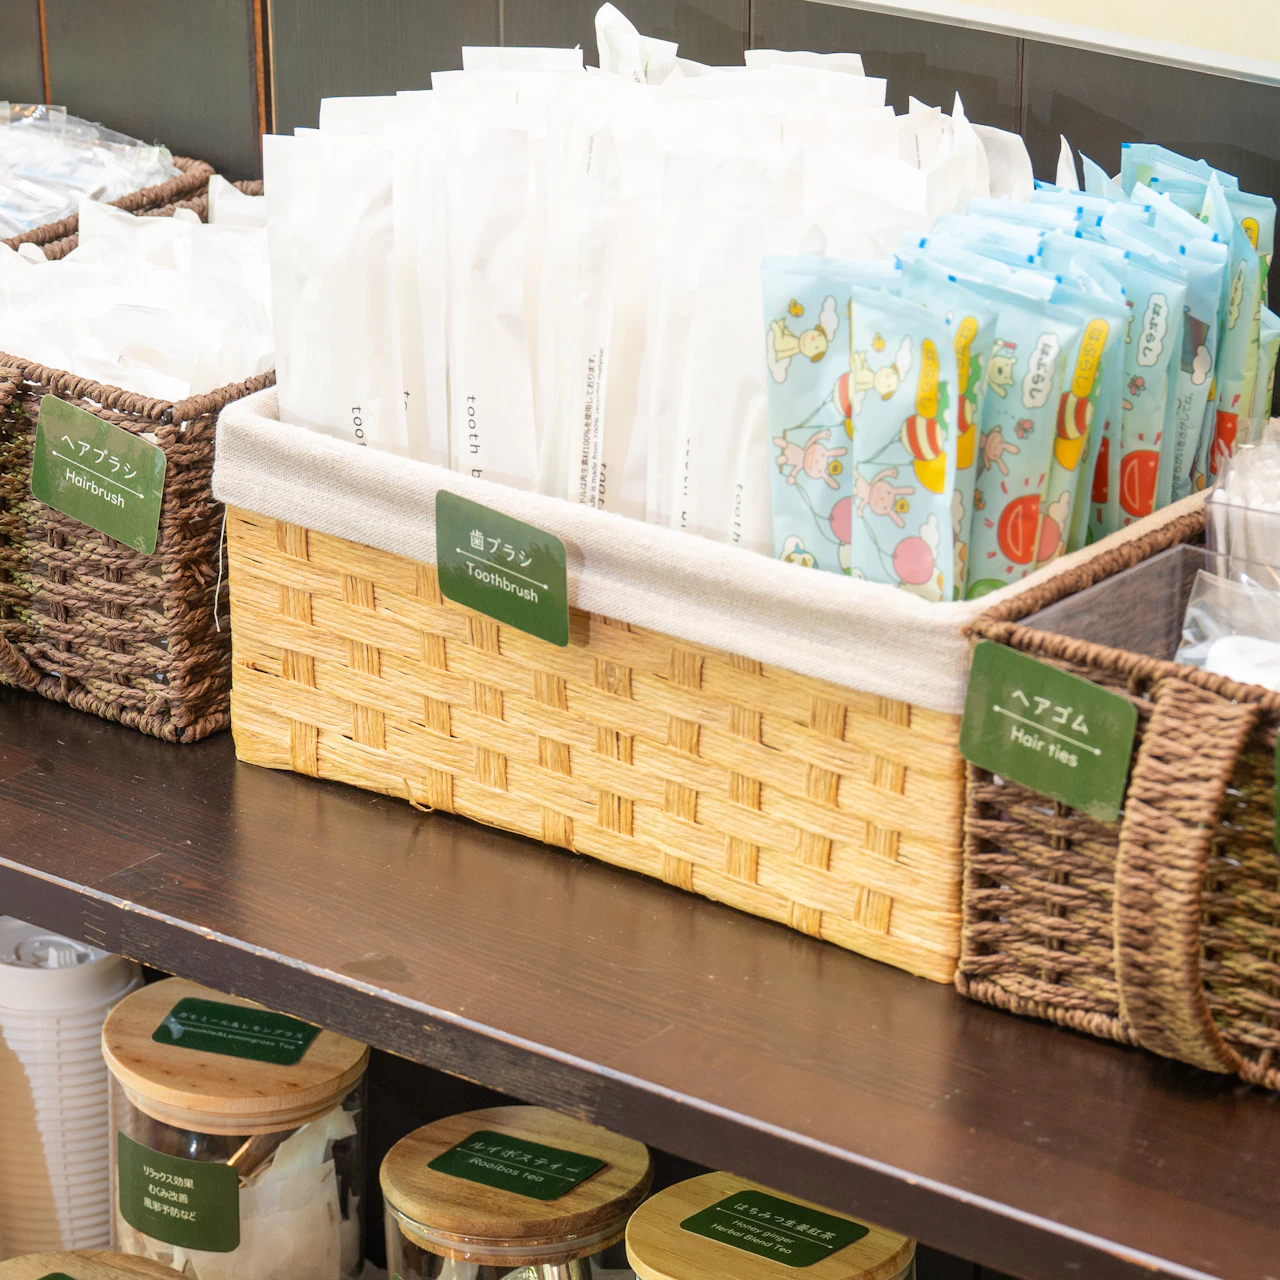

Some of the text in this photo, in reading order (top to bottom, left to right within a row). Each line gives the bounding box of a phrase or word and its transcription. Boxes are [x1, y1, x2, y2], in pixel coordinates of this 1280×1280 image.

[1136, 299, 1164, 363] はぶらし
[1029, 343, 1053, 400] はぶらし
[1075, 327, 1104, 388] はぶらし
[467, 395, 480, 455] tooth
[60, 433, 138, 479] ヘアブラシ
[65, 467, 125, 509] Hairbrush
[469, 529, 532, 568] 歯ブラシ
[466, 561, 539, 604] Toothbrush
[1011, 688, 1090, 736] ヘアゴム
[1010, 724, 1079, 769] Hair ties
[143, 1165, 194, 1189] リラックス効果
[469, 1140, 581, 1173] ルイボスティー
[469, 1156, 544, 1184] Rooibos tea
[144, 1196, 196, 1221] 風邪予防など
[148, 1184, 188, 1204] むくみ改善
[711, 1221, 793, 1256] Herbal Blend Tea
[731, 1218, 795, 1247] Honey ginger
[732, 1201, 838, 1242] はちみつ生姜紅茶
